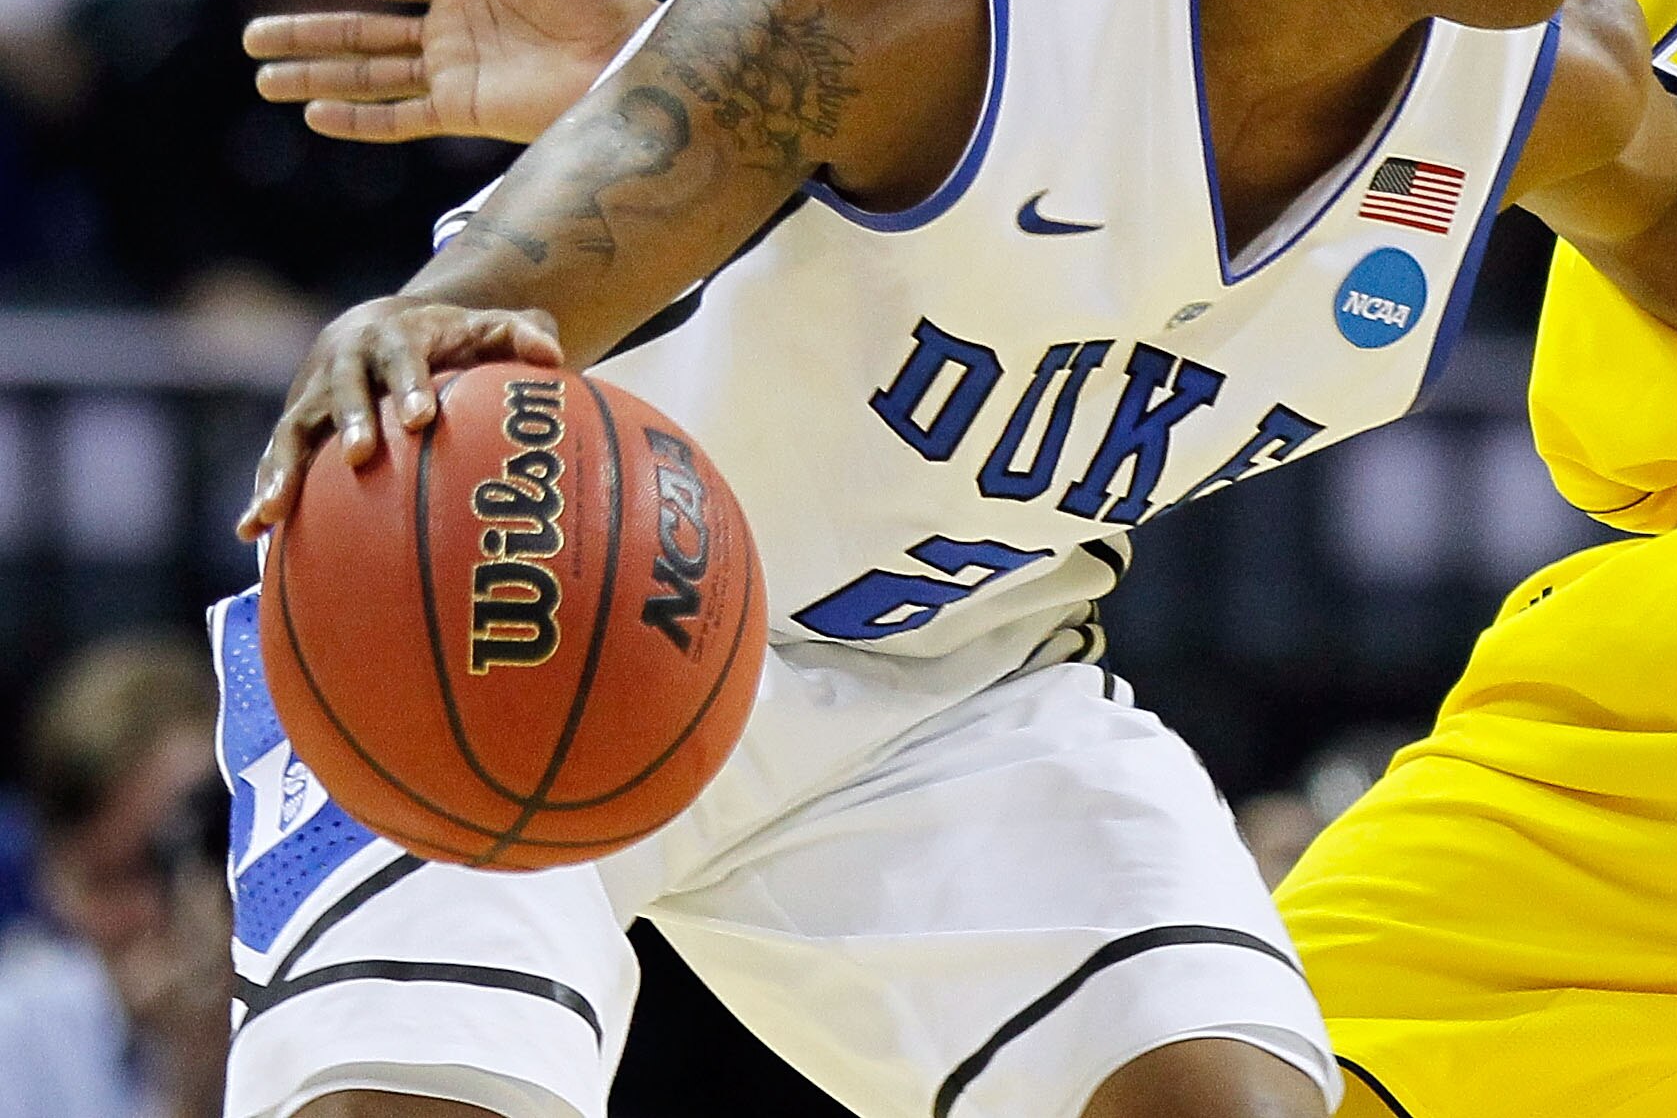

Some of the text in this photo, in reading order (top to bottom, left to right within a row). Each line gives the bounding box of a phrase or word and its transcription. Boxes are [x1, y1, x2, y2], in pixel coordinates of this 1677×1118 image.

[1342, 290, 1412, 330] NCAA
[467, 377, 566, 676] Wilson
[868, 317, 1328, 527] DUKE
[641, 427, 711, 654] NCAA
